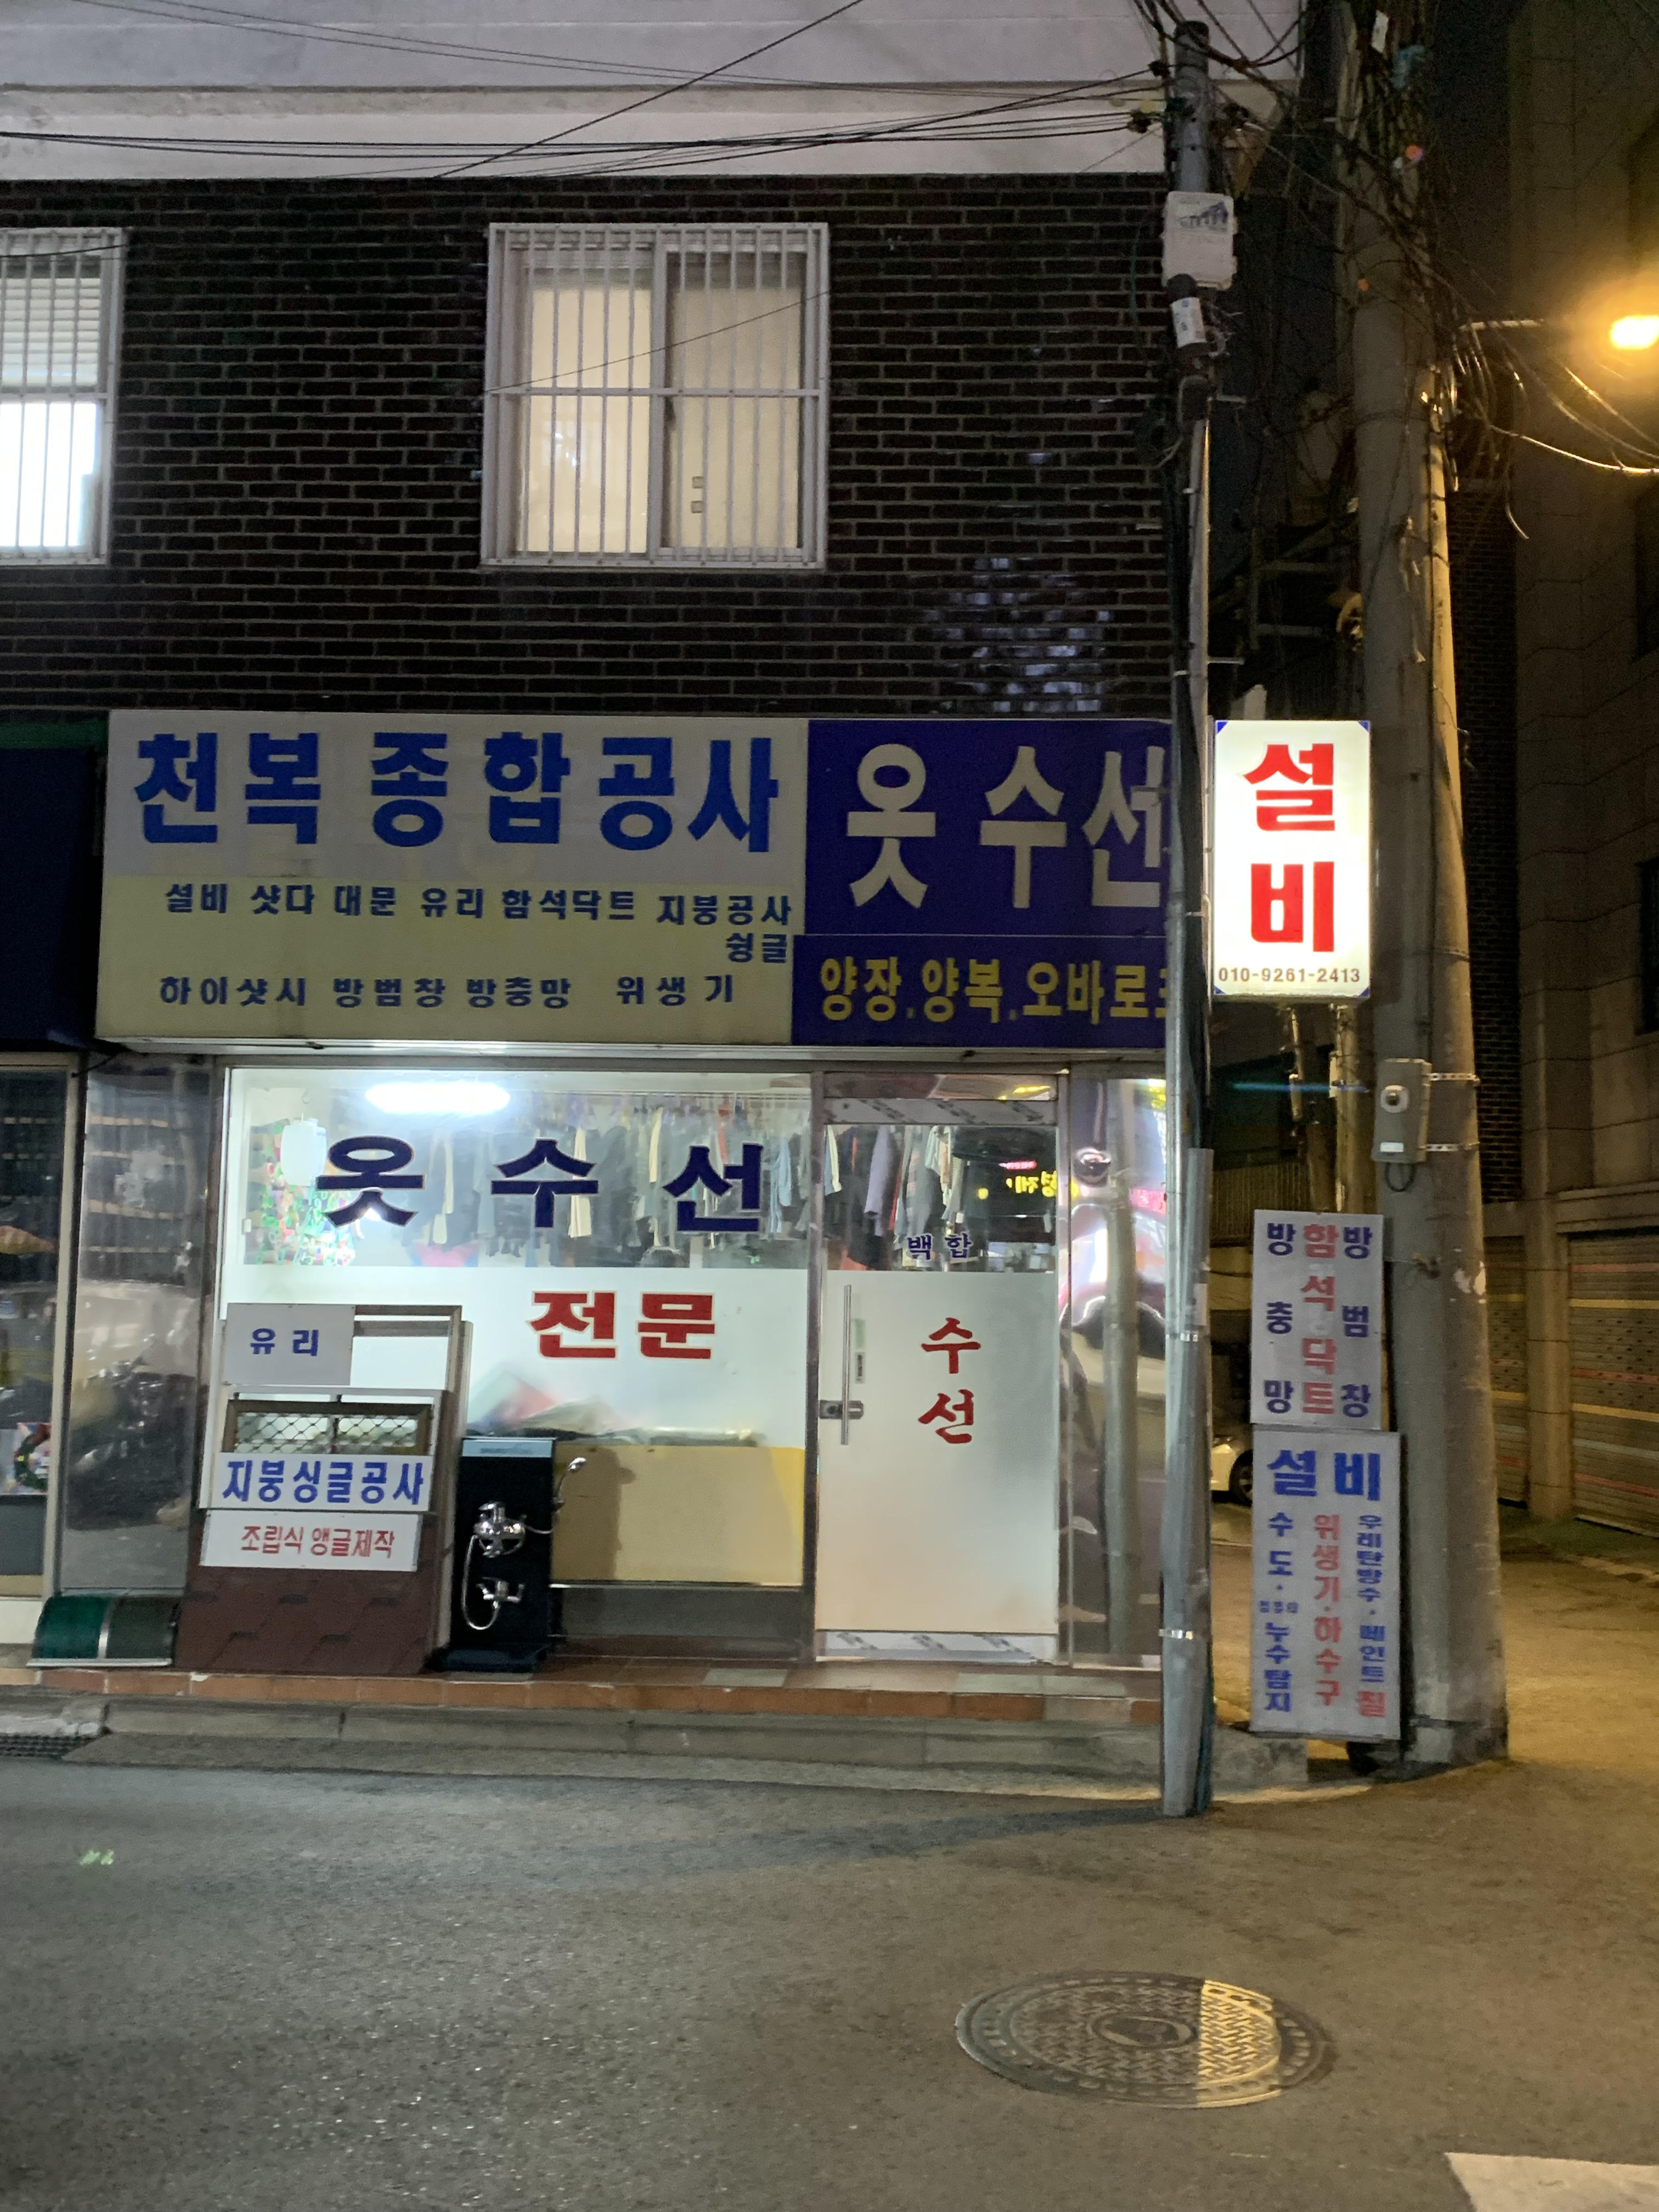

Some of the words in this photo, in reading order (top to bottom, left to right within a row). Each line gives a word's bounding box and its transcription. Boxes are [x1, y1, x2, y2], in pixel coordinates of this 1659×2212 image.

[1243, 743, 1335, 953] 설비
[166, 883, 228, 913] 설비
[250, 884, 315, 915] 샷다
[334, 885, 396, 916] 대문
[421, 888, 484, 918] 유리
[657, 895, 791, 926] 지붕공사
[160, 977, 306, 1006] 하이샷시
[333, 978, 445, 1008] 방범창
[466, 977, 571, 1008] 방충망
[617, 975, 733, 1006] 위생기
[1023, 960, 1167, 1025] 오바로
[1218, 967, 1360, 983] 010-9261-2413
[907, 1232, 973, 1261] 백합
[250, 1328, 319, 1357] 유리
[531, 1291, 715, 1359] 전문
[1264, 1223, 1295, 1414] 방충망
[1341, 1227, 1373, 1418] 방범창
[918, 1317, 981, 1444] 수선
[222, 1459, 425, 1505] 지붕싱글공사
[1267, 1449, 1382, 1502] 설비
[241, 1525, 304, 1555] 조립식
[1264, 1622, 1293, 1712] 누수탐지
